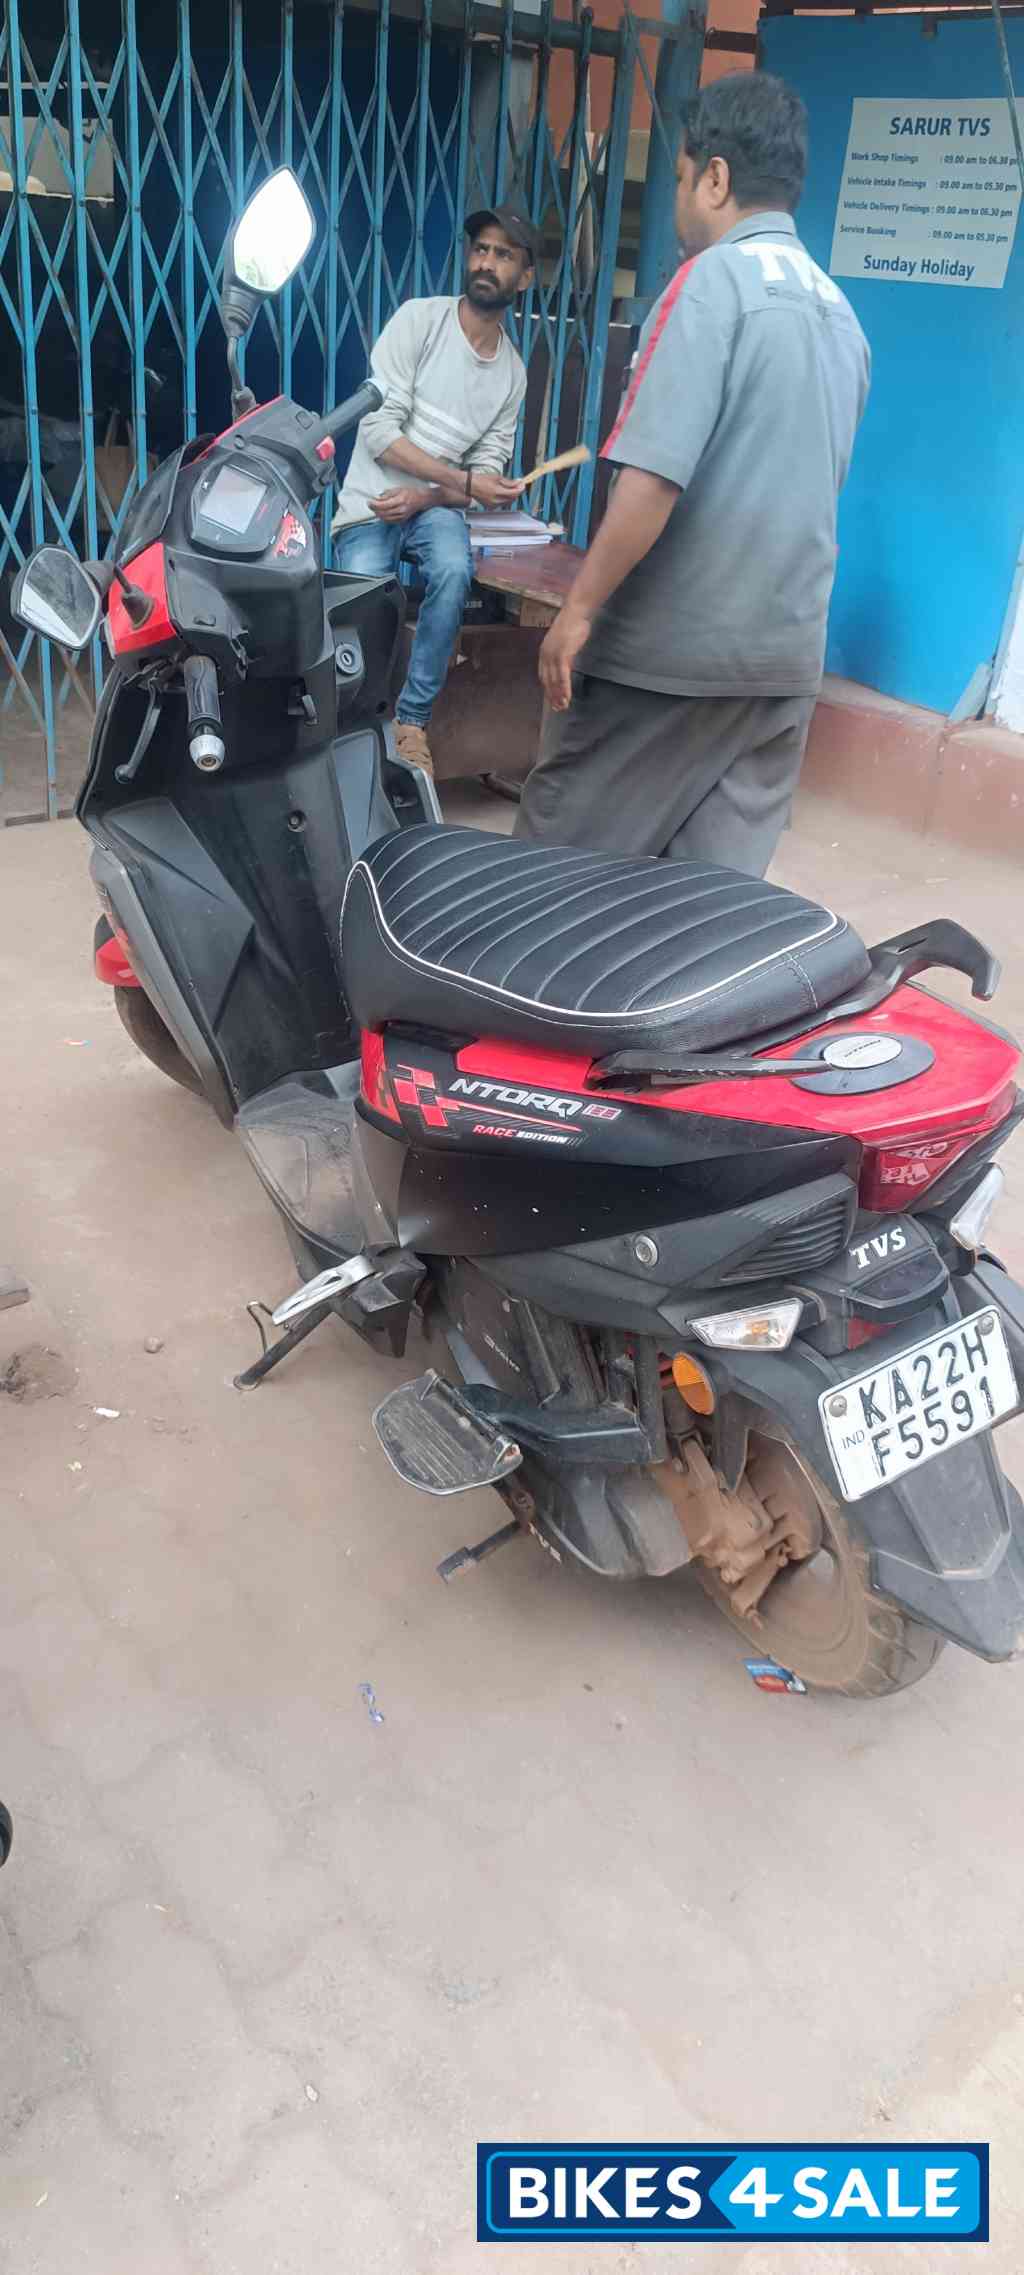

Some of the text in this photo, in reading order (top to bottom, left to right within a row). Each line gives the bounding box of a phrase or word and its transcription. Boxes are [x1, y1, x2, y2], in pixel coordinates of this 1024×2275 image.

[889, 117, 991, 137] SARUR TVS
[851, 152, 869, 161] Work
[871, 153, 889, 164] Shop
[891, 153, 919, 164] Timings
[979, 156, 987, 165] to
[847, 176, 872, 186] Vehicle
[874, 178, 896, 187] Intake
[898, 178, 927, 190] Timings
[962, 182, 973, 190] am
[975, 181, 983, 190] to
[1005, 184, 1017, 192] pm
[843, 200, 868, 210] Vehicle
[870, 202, 900, 214] Delivery
[902, 203, 930, 215] Timings
[971, 207, 979, 215] to
[1000, 210, 1013, 218] pm
[840, 224, 865, 233] Service
[867, 226, 897, 238] Booking
[954, 232, 966, 240] am
[967, 232, 975, 240] to
[996, 234, 1009, 243] pm
[737, 242, 841, 303] TVS
[863, 255, 975, 281] Sunday Holiday
[448, 1078, 583, 1120] NTORQ
[472, 1124, 569, 1145] RACE EDITION
[850, 1227, 906, 1269] TVS
[858, 1326, 989, 1429] KA22H
[870, 1376, 995, 1477] F5591
[841, 1430, 865, 1450] IND
